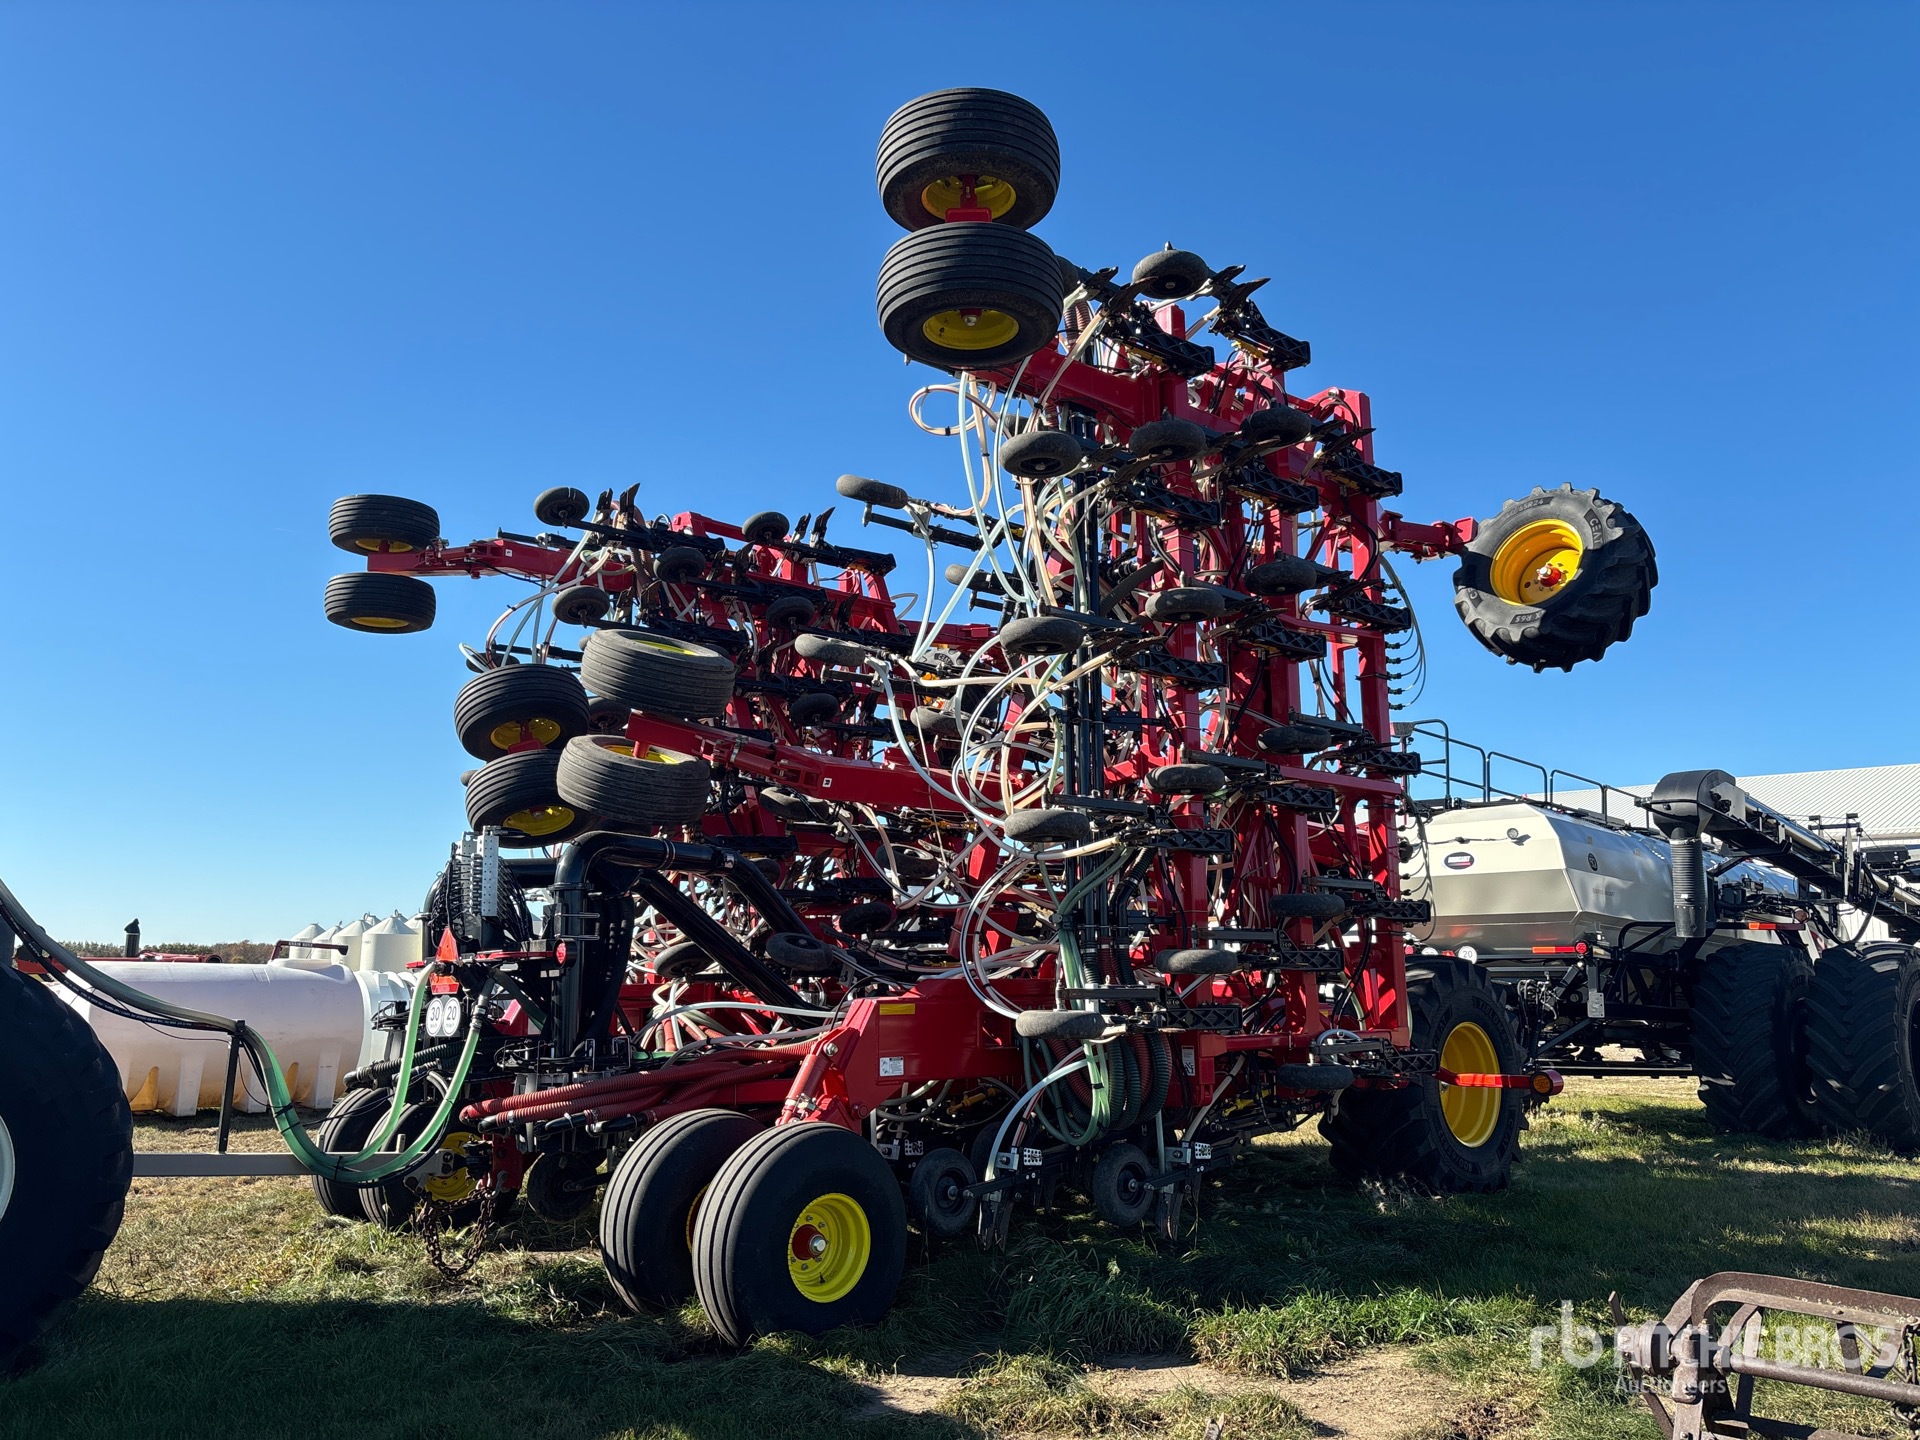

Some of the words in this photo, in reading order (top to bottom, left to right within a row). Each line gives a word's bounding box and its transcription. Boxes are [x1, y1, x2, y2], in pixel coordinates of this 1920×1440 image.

[1588, 518, 1604, 546] CEAT
[1462, 950, 1473, 959] 20
[430, 1006, 441, 1021] 30
[446, 1005, 457, 1021] 20
